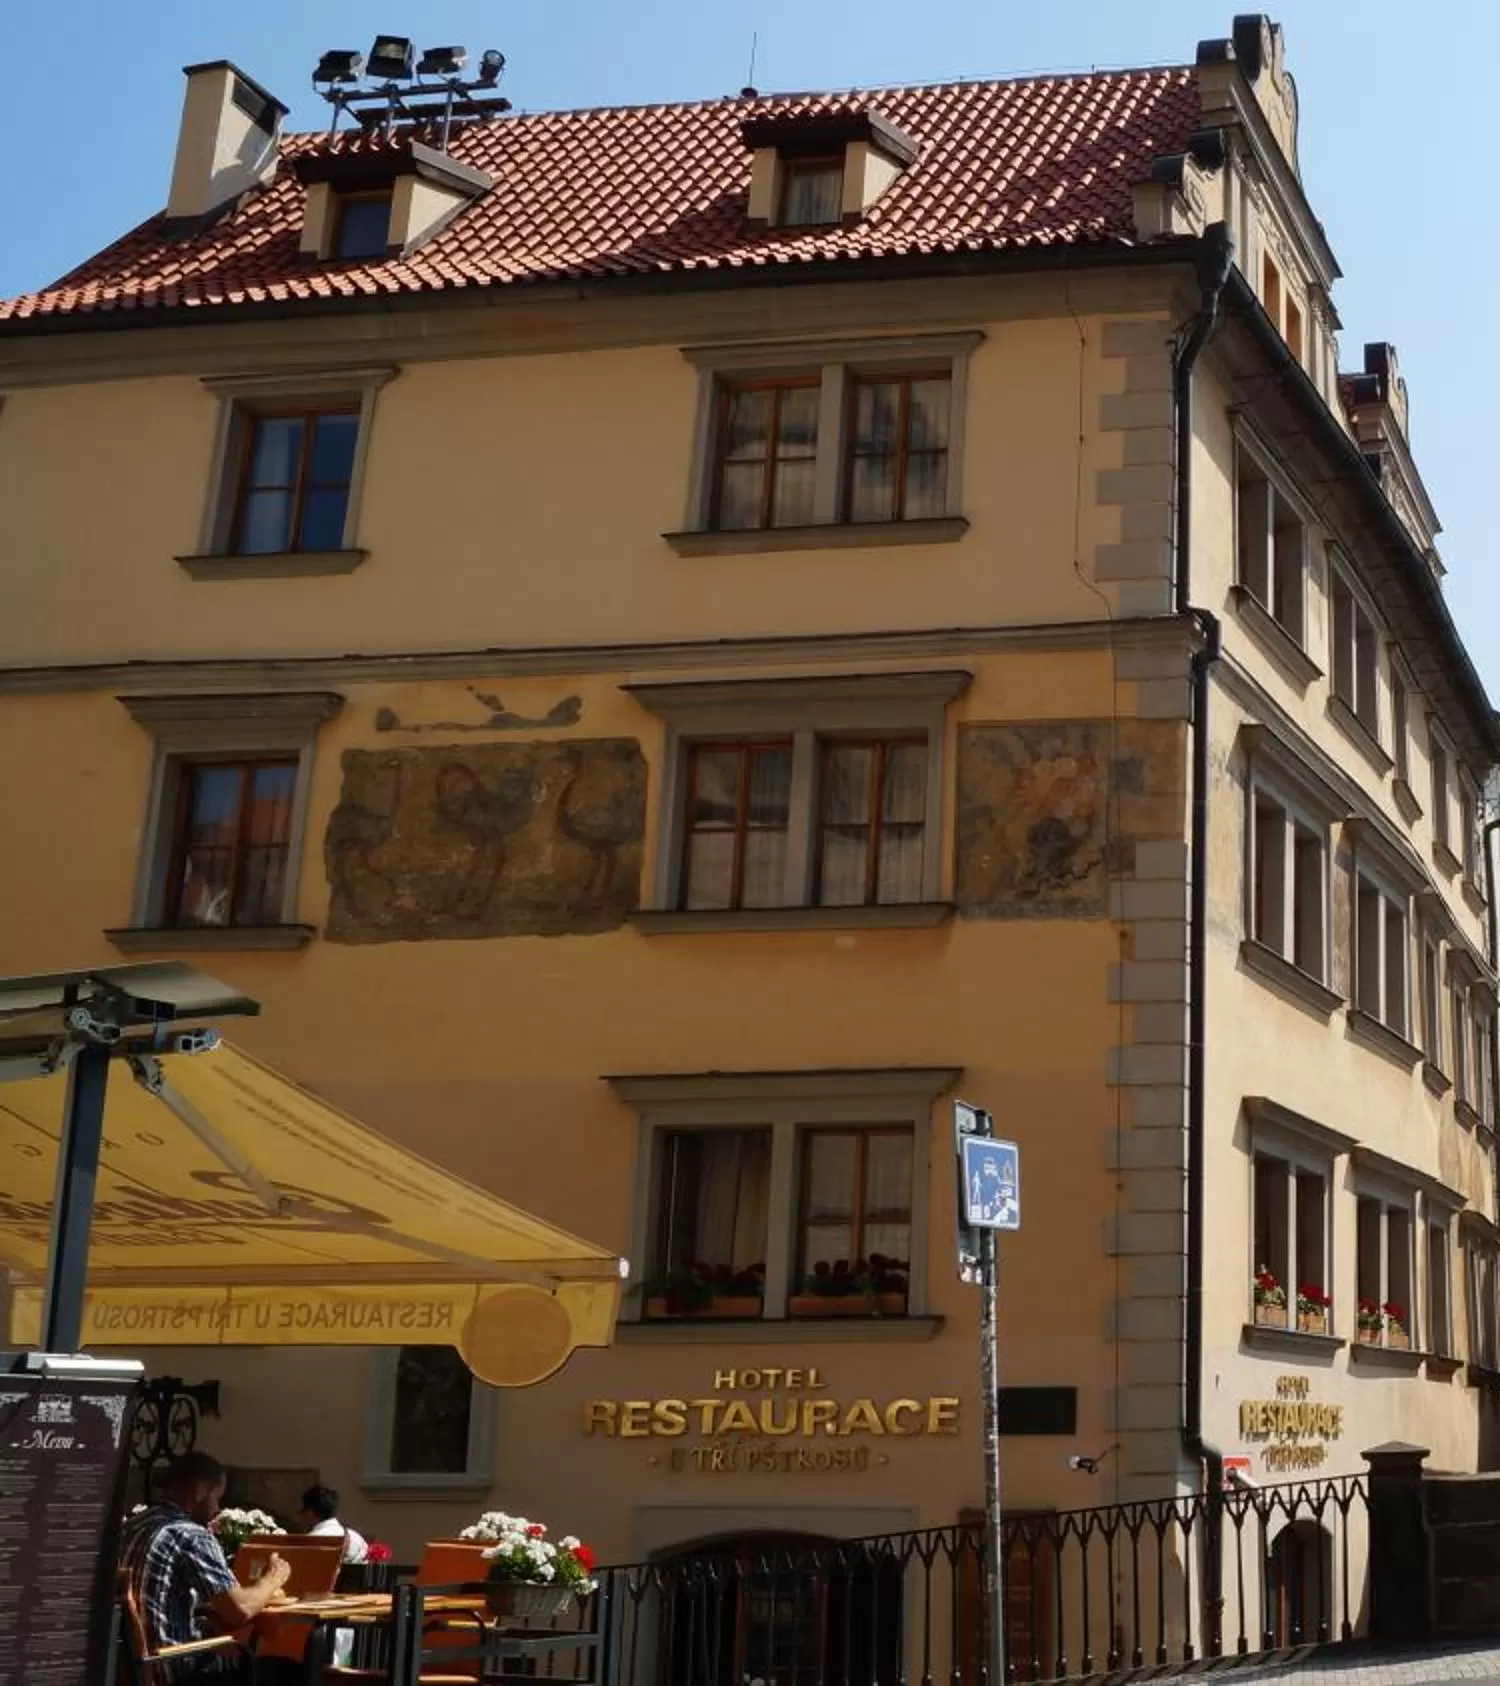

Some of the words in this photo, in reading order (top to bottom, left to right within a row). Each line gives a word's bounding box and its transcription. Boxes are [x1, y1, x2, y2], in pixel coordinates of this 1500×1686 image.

[714, 1368, 830, 1389] HOTEL
[581, 1396, 960, 1438] RESTAURACE
[22, 1429, 75, 1449] Menu
